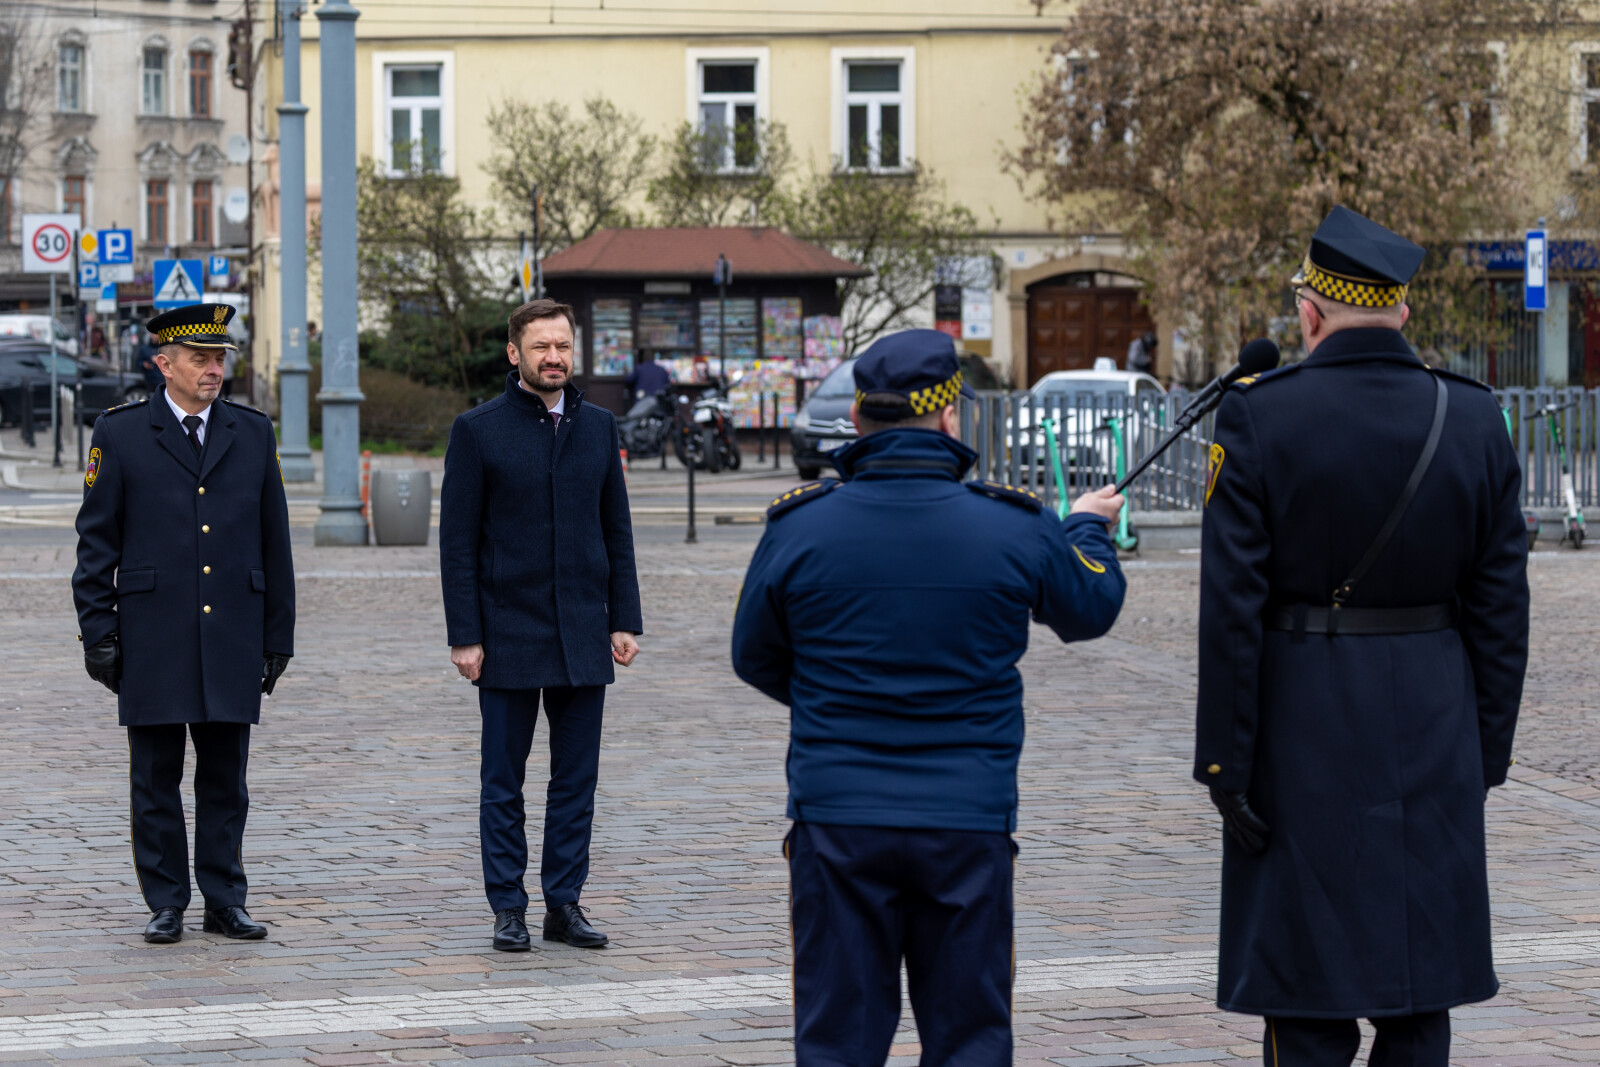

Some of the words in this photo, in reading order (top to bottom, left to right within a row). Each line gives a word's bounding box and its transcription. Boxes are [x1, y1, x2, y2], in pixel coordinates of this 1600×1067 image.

[37, 234, 66, 253] 30
[105, 232, 126, 261] P
[213, 257, 226, 274] P
[1531, 251, 1543, 269] WC
[81, 263, 97, 286] P
